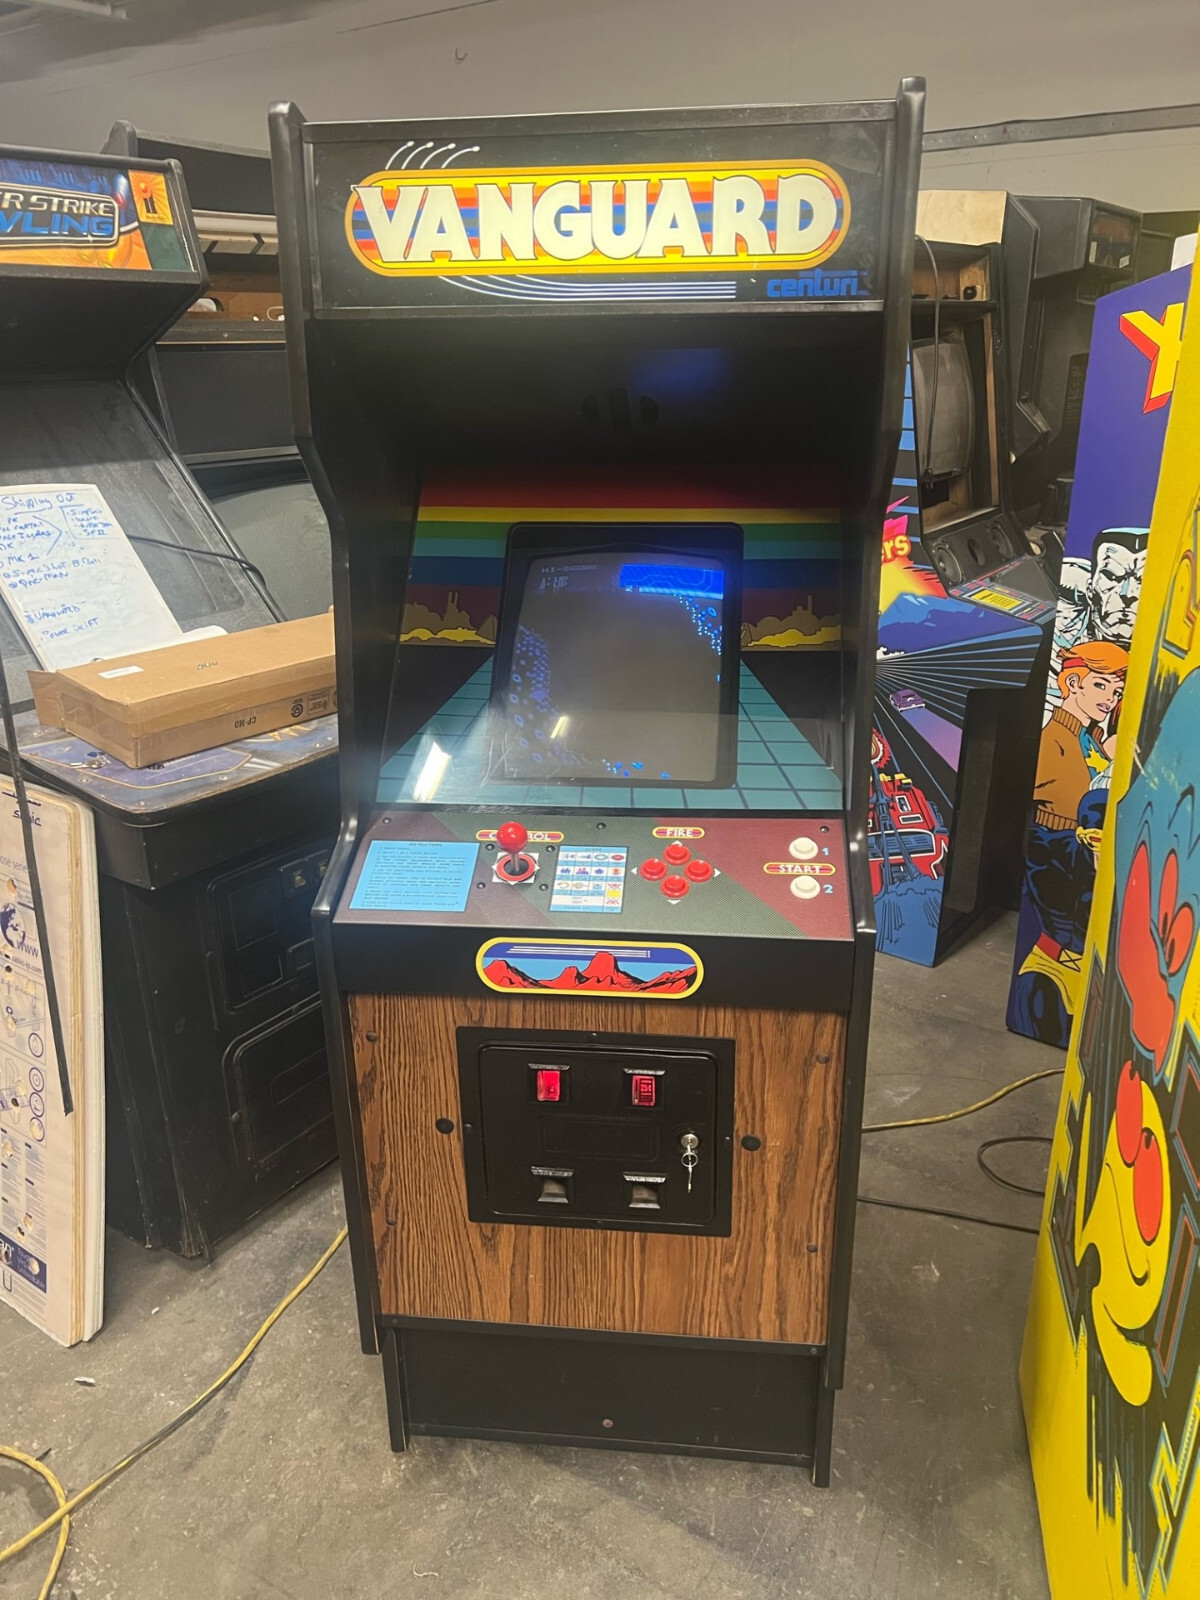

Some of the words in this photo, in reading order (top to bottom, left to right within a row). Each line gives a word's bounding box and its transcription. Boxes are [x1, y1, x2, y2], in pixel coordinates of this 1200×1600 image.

[0, 192, 22, 210] R
[28, 195, 114, 217] STRIKE
[353, 174, 838, 262] VANGUARD
[767, 268, 859, 298] centuri
[666, 828, 694, 838] FIRE
[822, 847, 829, 856] 1
[778, 864, 822, 874] START
[823, 884, 834, 894] 2
